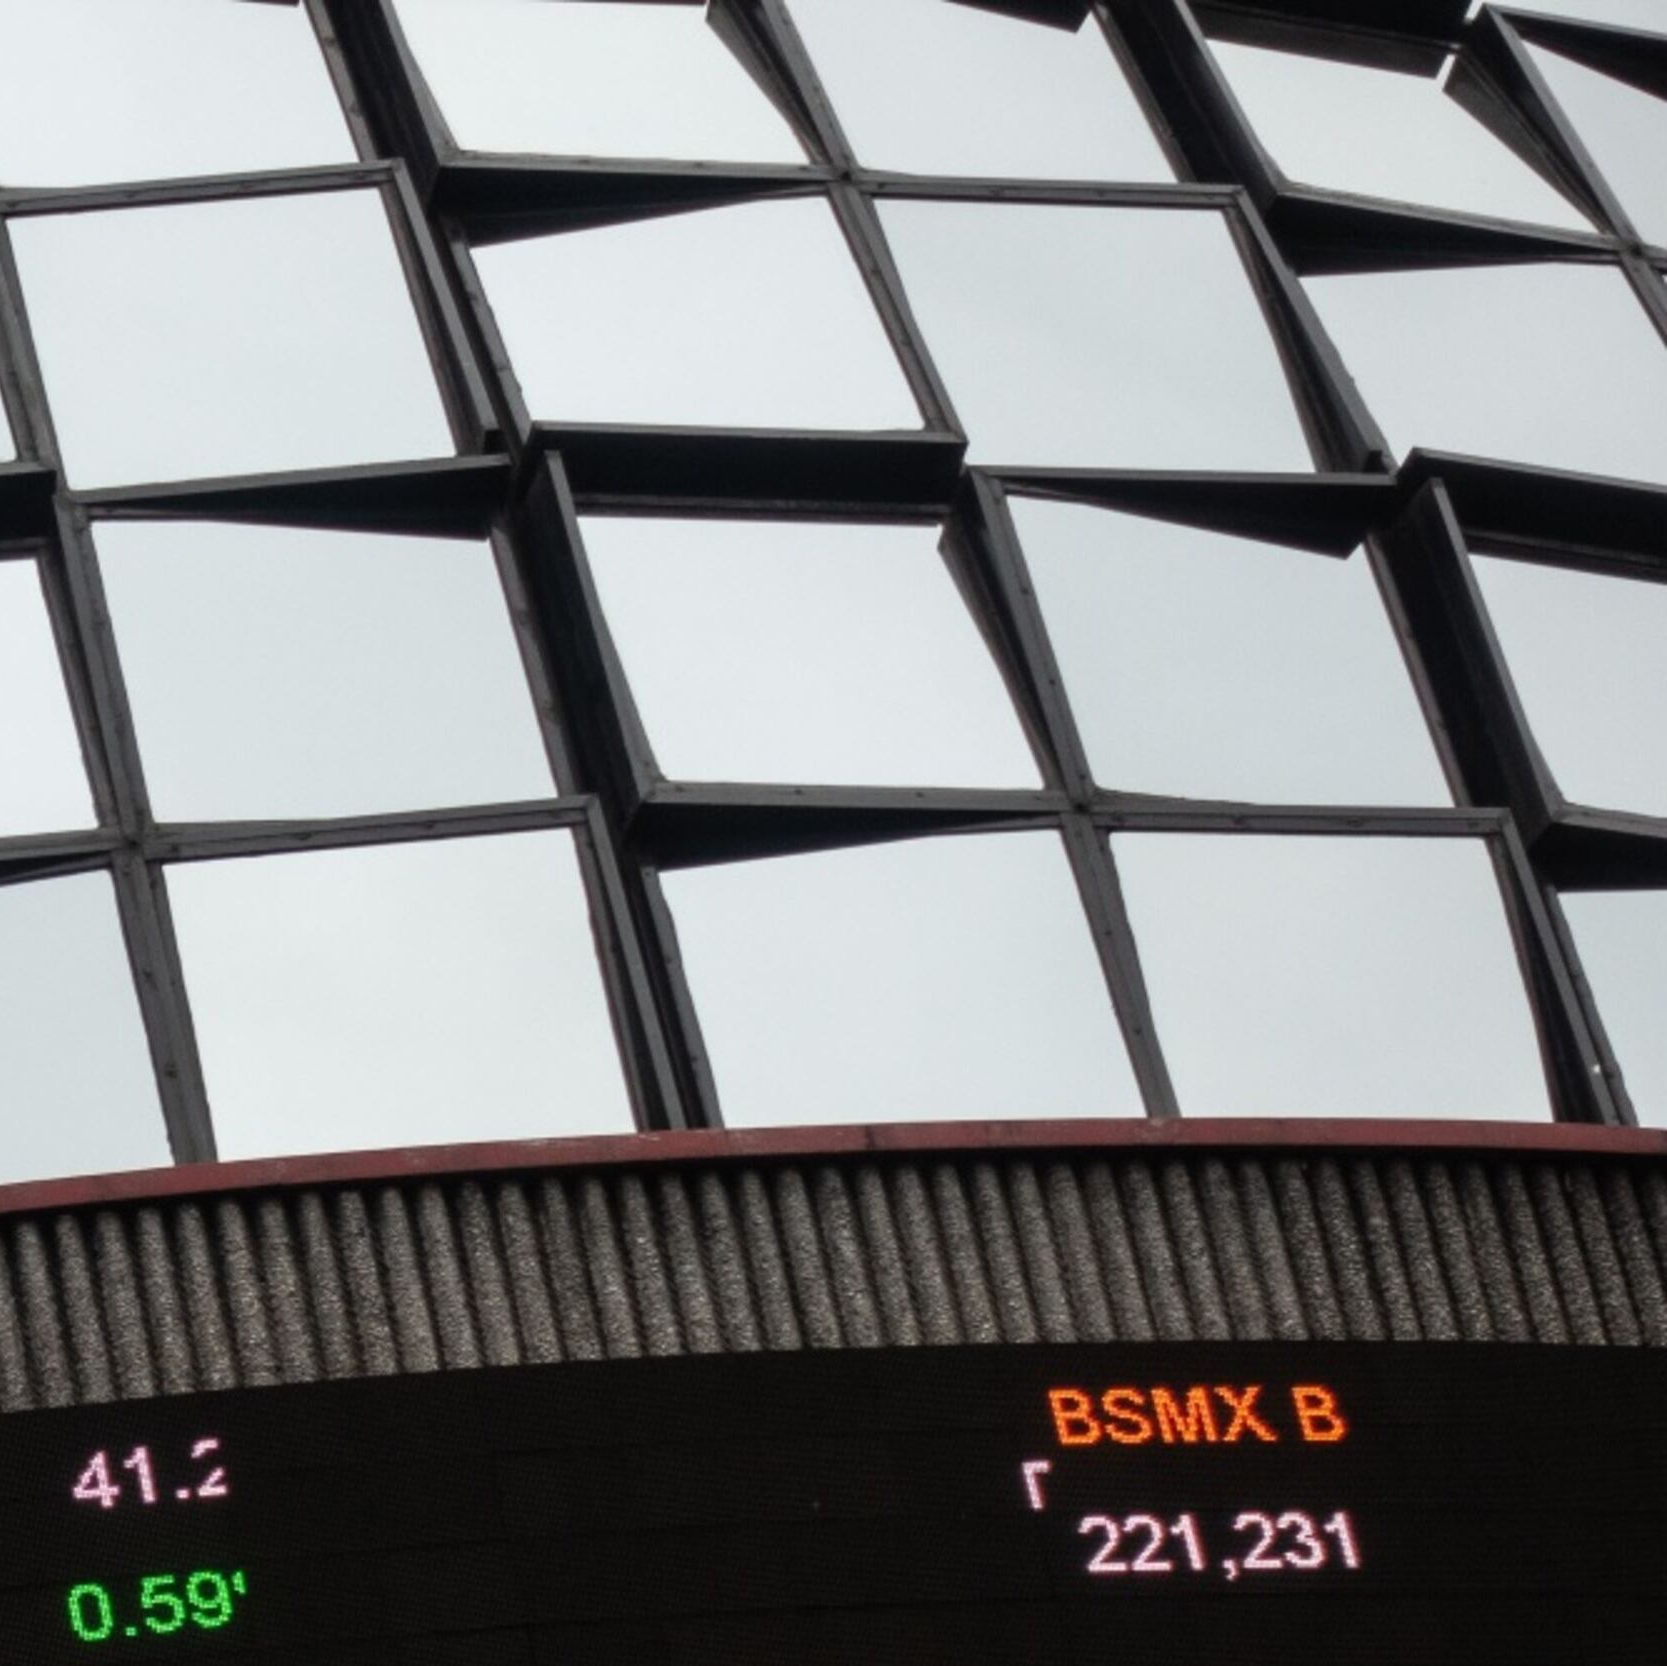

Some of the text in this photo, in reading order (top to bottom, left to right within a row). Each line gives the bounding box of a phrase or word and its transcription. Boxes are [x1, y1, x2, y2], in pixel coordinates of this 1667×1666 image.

[1047, 1384, 1349, 1446] BSMX B
[1077, 1510, 1361, 1581] 221,231
[67, 1570, 247, 1642] 0.59
